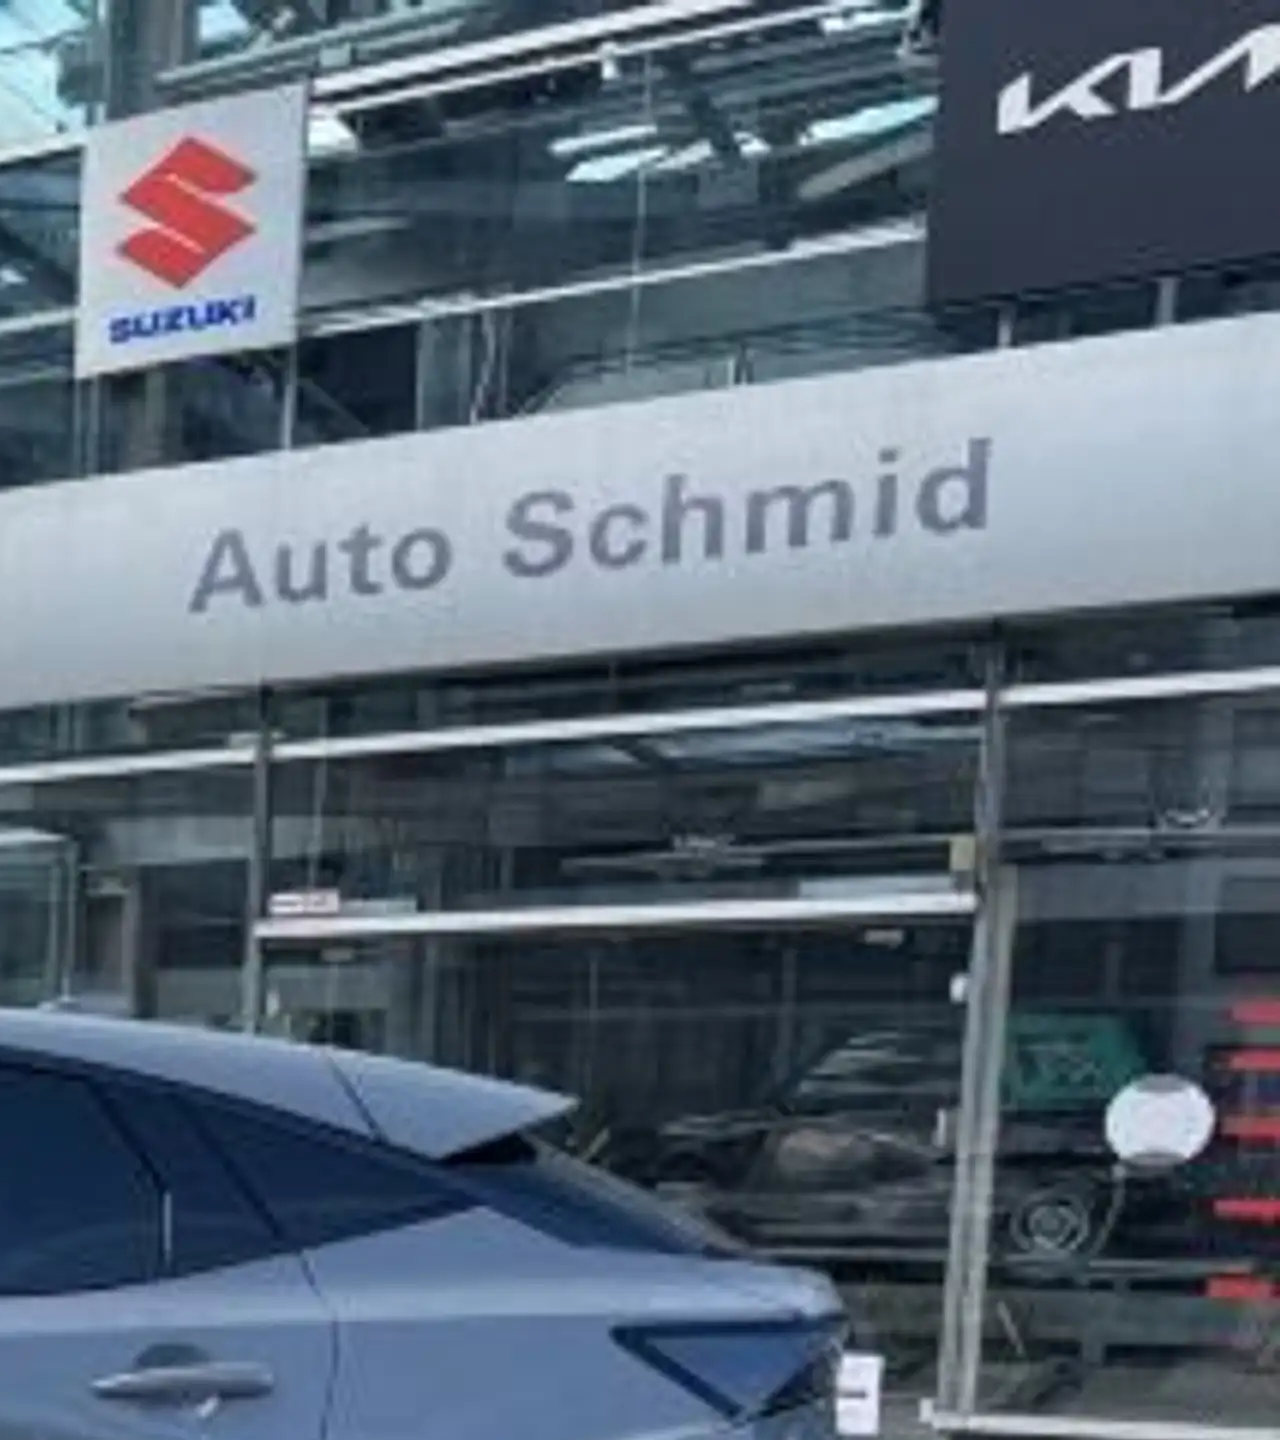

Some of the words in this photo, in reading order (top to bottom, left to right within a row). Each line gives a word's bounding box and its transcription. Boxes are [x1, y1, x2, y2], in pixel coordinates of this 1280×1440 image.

[108, 295, 256, 344] SUZUKI
[187, 522, 454, 614] Auto
[502, 437, 993, 580] Schmid
